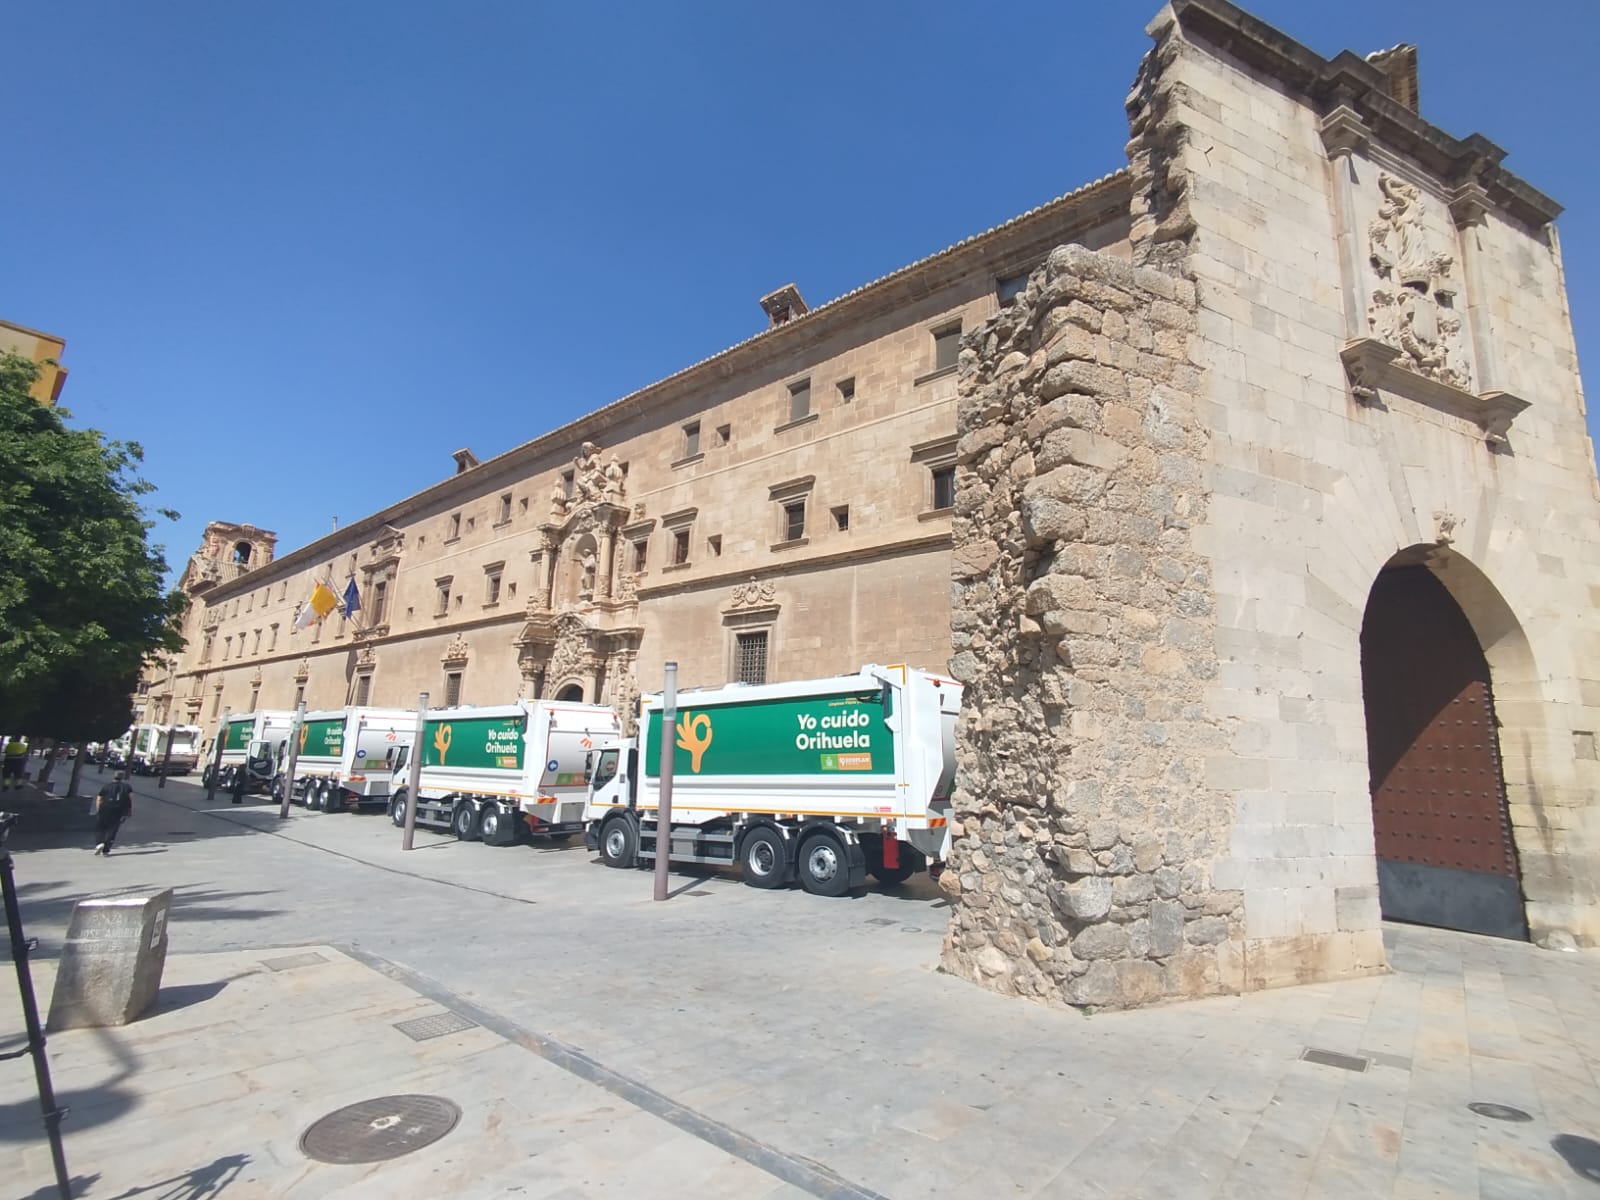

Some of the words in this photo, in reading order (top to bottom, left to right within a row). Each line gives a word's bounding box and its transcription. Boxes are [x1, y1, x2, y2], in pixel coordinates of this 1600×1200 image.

[797, 714, 817, 730] Yo
[821, 709, 870, 729] cuido
[488, 729, 497, 740] Yo
[497, 728, 519, 740] cuido
[796, 730, 871, 750] Orihuela
[485, 742, 517, 753] Orihuela
